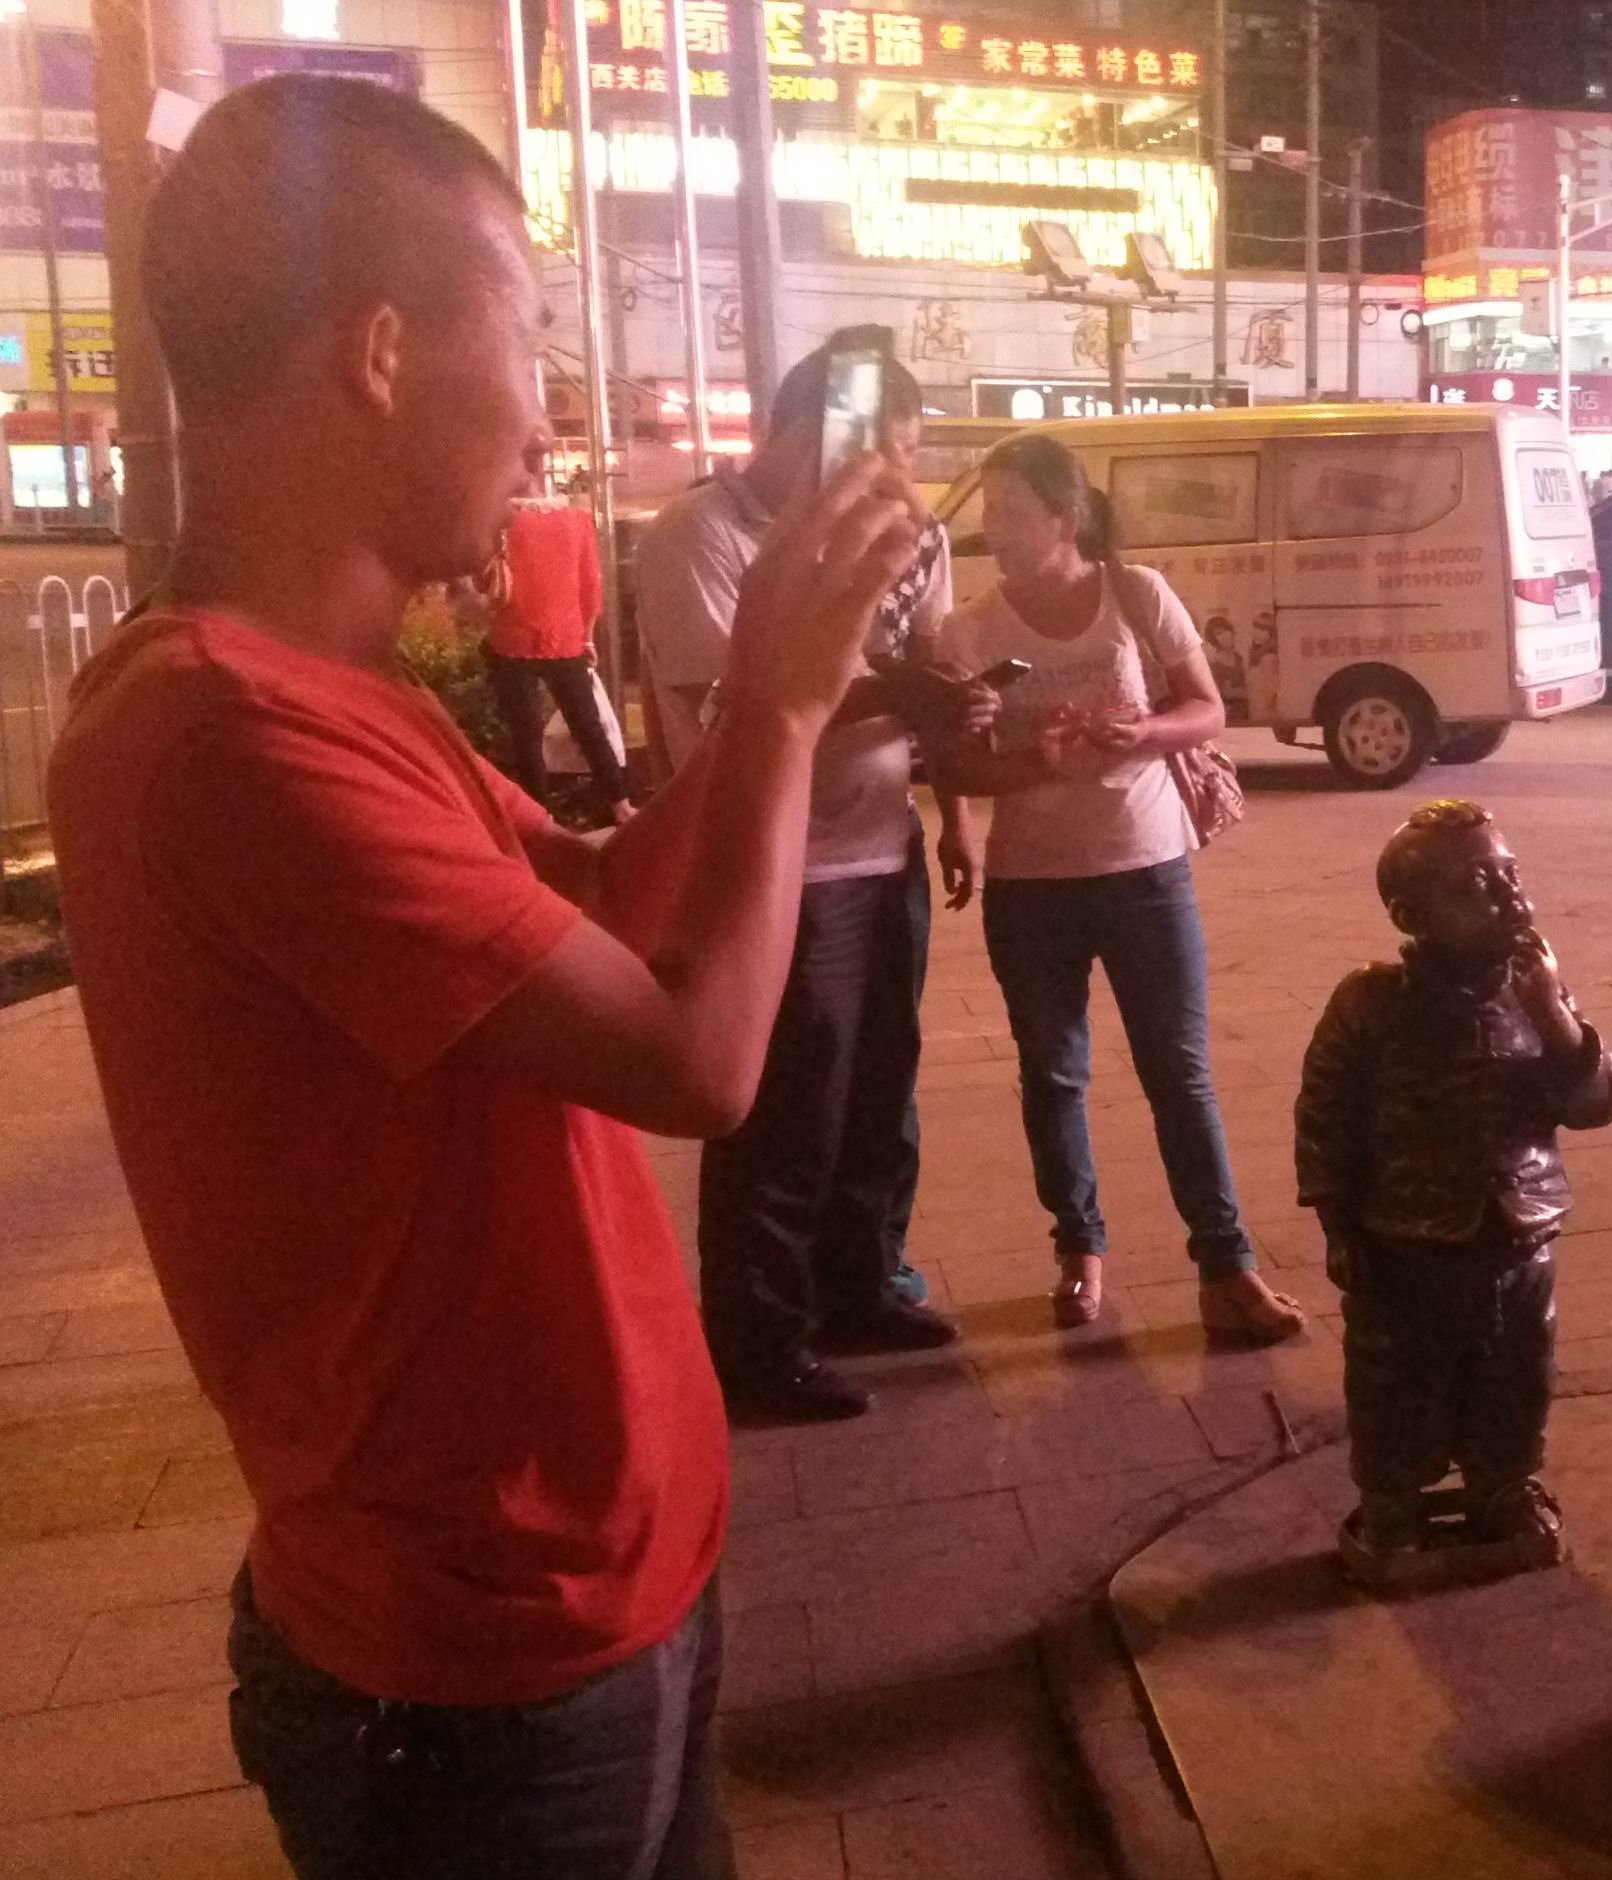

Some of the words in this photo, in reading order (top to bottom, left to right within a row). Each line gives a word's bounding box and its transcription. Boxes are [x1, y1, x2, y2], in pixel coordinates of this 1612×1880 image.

[981, 37, 1086, 79] 家常菜
[1096, 47, 1198, 87] 特色菜
